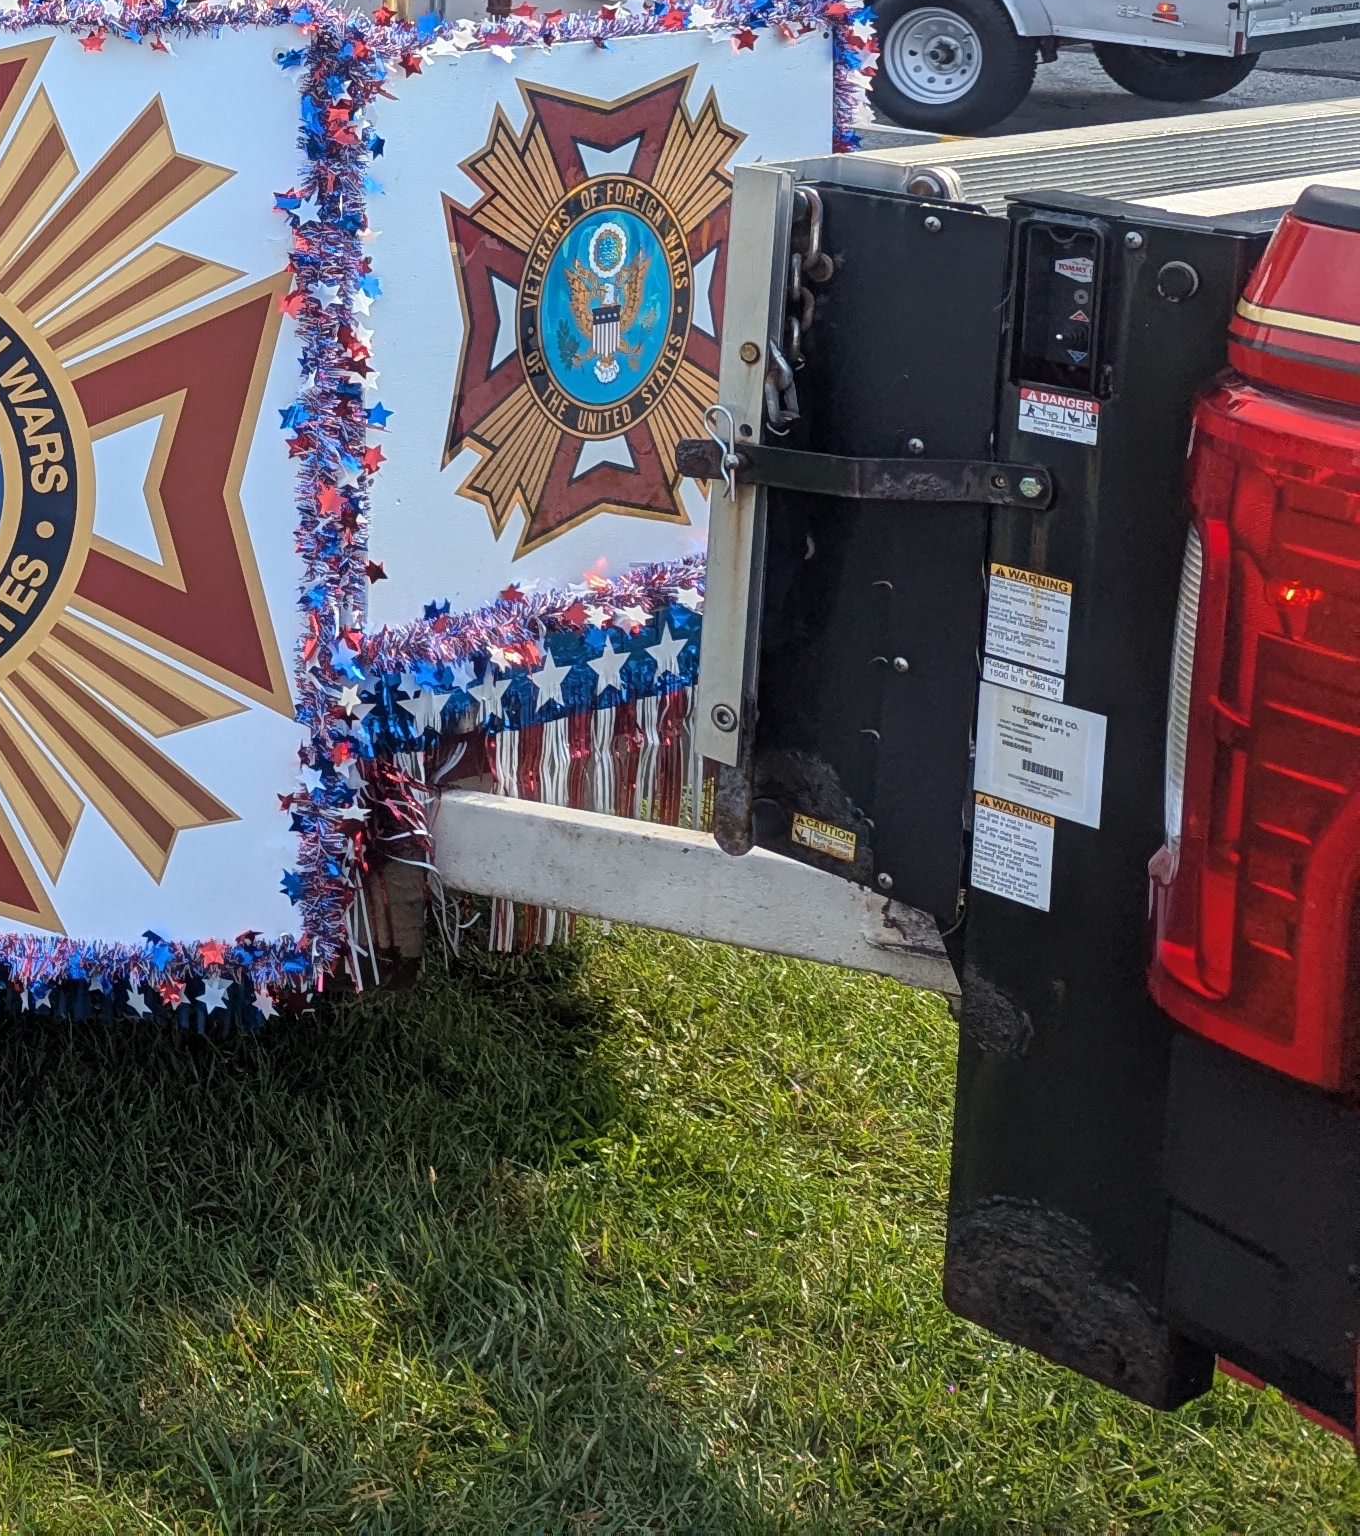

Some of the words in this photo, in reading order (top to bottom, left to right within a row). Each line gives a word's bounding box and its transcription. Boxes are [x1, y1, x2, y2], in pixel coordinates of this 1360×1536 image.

[523, 208, 571, 309] VETERANS
[580, 186, 598, 210] OF
[606, 183, 666, 227] FOREIGN
[664, 228, 689, 290] WARS
[526, 351, 544, 374] OF
[542, 382, 570, 420] THE
[577, 405, 632, 433] UNITED
[641, 333, 683, 406] STATES
[1040, 392, 1093, 411] DANGER
[1008, 568, 1068, 592] WARNING
[985, 658, 1009, 671] Rated
[1011, 665, 1024, 675] Lift
[1025, 669, 1061, 687] Capacity
[989, 667, 1008, 679] 1500
[1047, 684, 1057, 695] kg
[1011, 704, 1040, 719] TOMMY
[1041, 713, 1063, 726] GATE
[1064, 720, 1079, 731] CO.
[1022, 717, 1047, 730] TOMMY
[1049, 725, 1064, 735] LIFT
[992, 799, 1051, 825] WARNING
[806, 818, 854, 842] CAUTION
